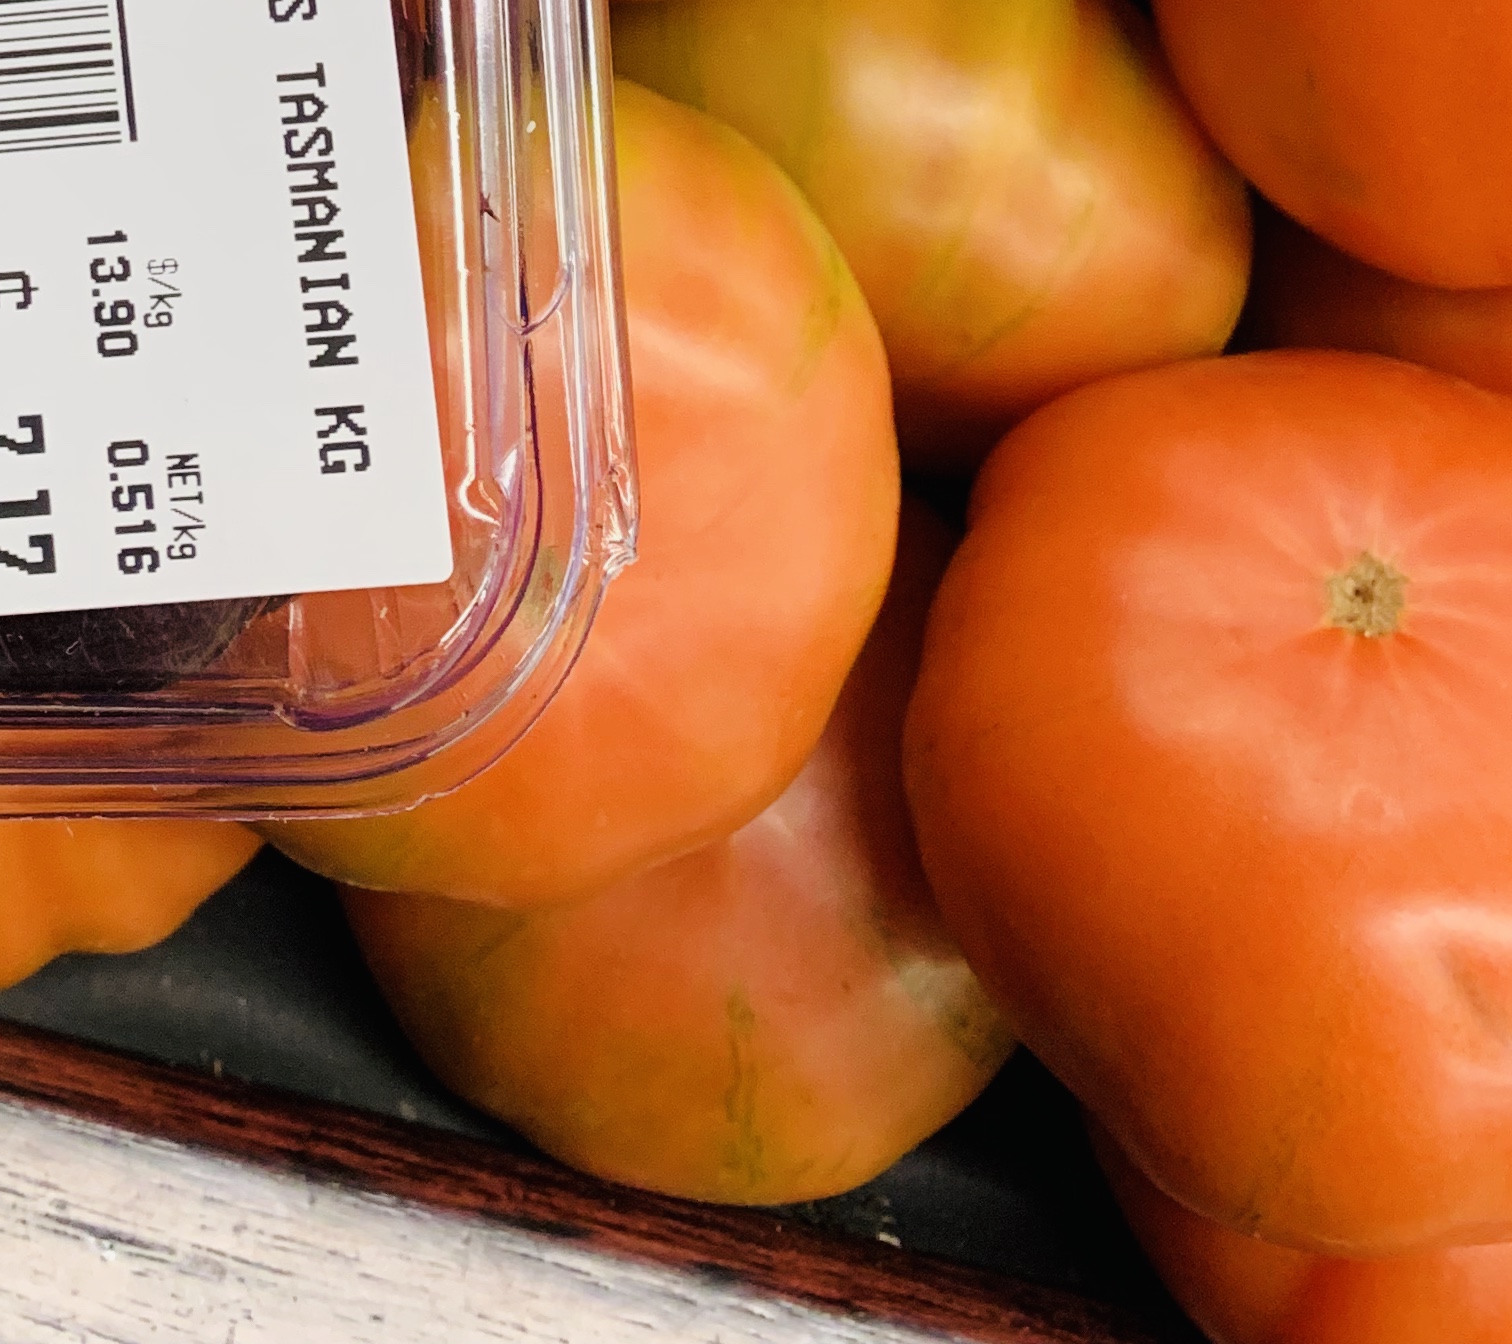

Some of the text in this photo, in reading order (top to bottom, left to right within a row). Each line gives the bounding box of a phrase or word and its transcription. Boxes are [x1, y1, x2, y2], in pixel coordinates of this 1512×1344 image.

[276, 62, 359, 368] TASMANIAN
[87, 230, 139, 358] 13.90
[143, 259, 178, 328] $/kg
[314, 405, 371, 474] KG
[107, 440, 160, 575] 0.516
[165, 453, 206, 560] NET/kg
